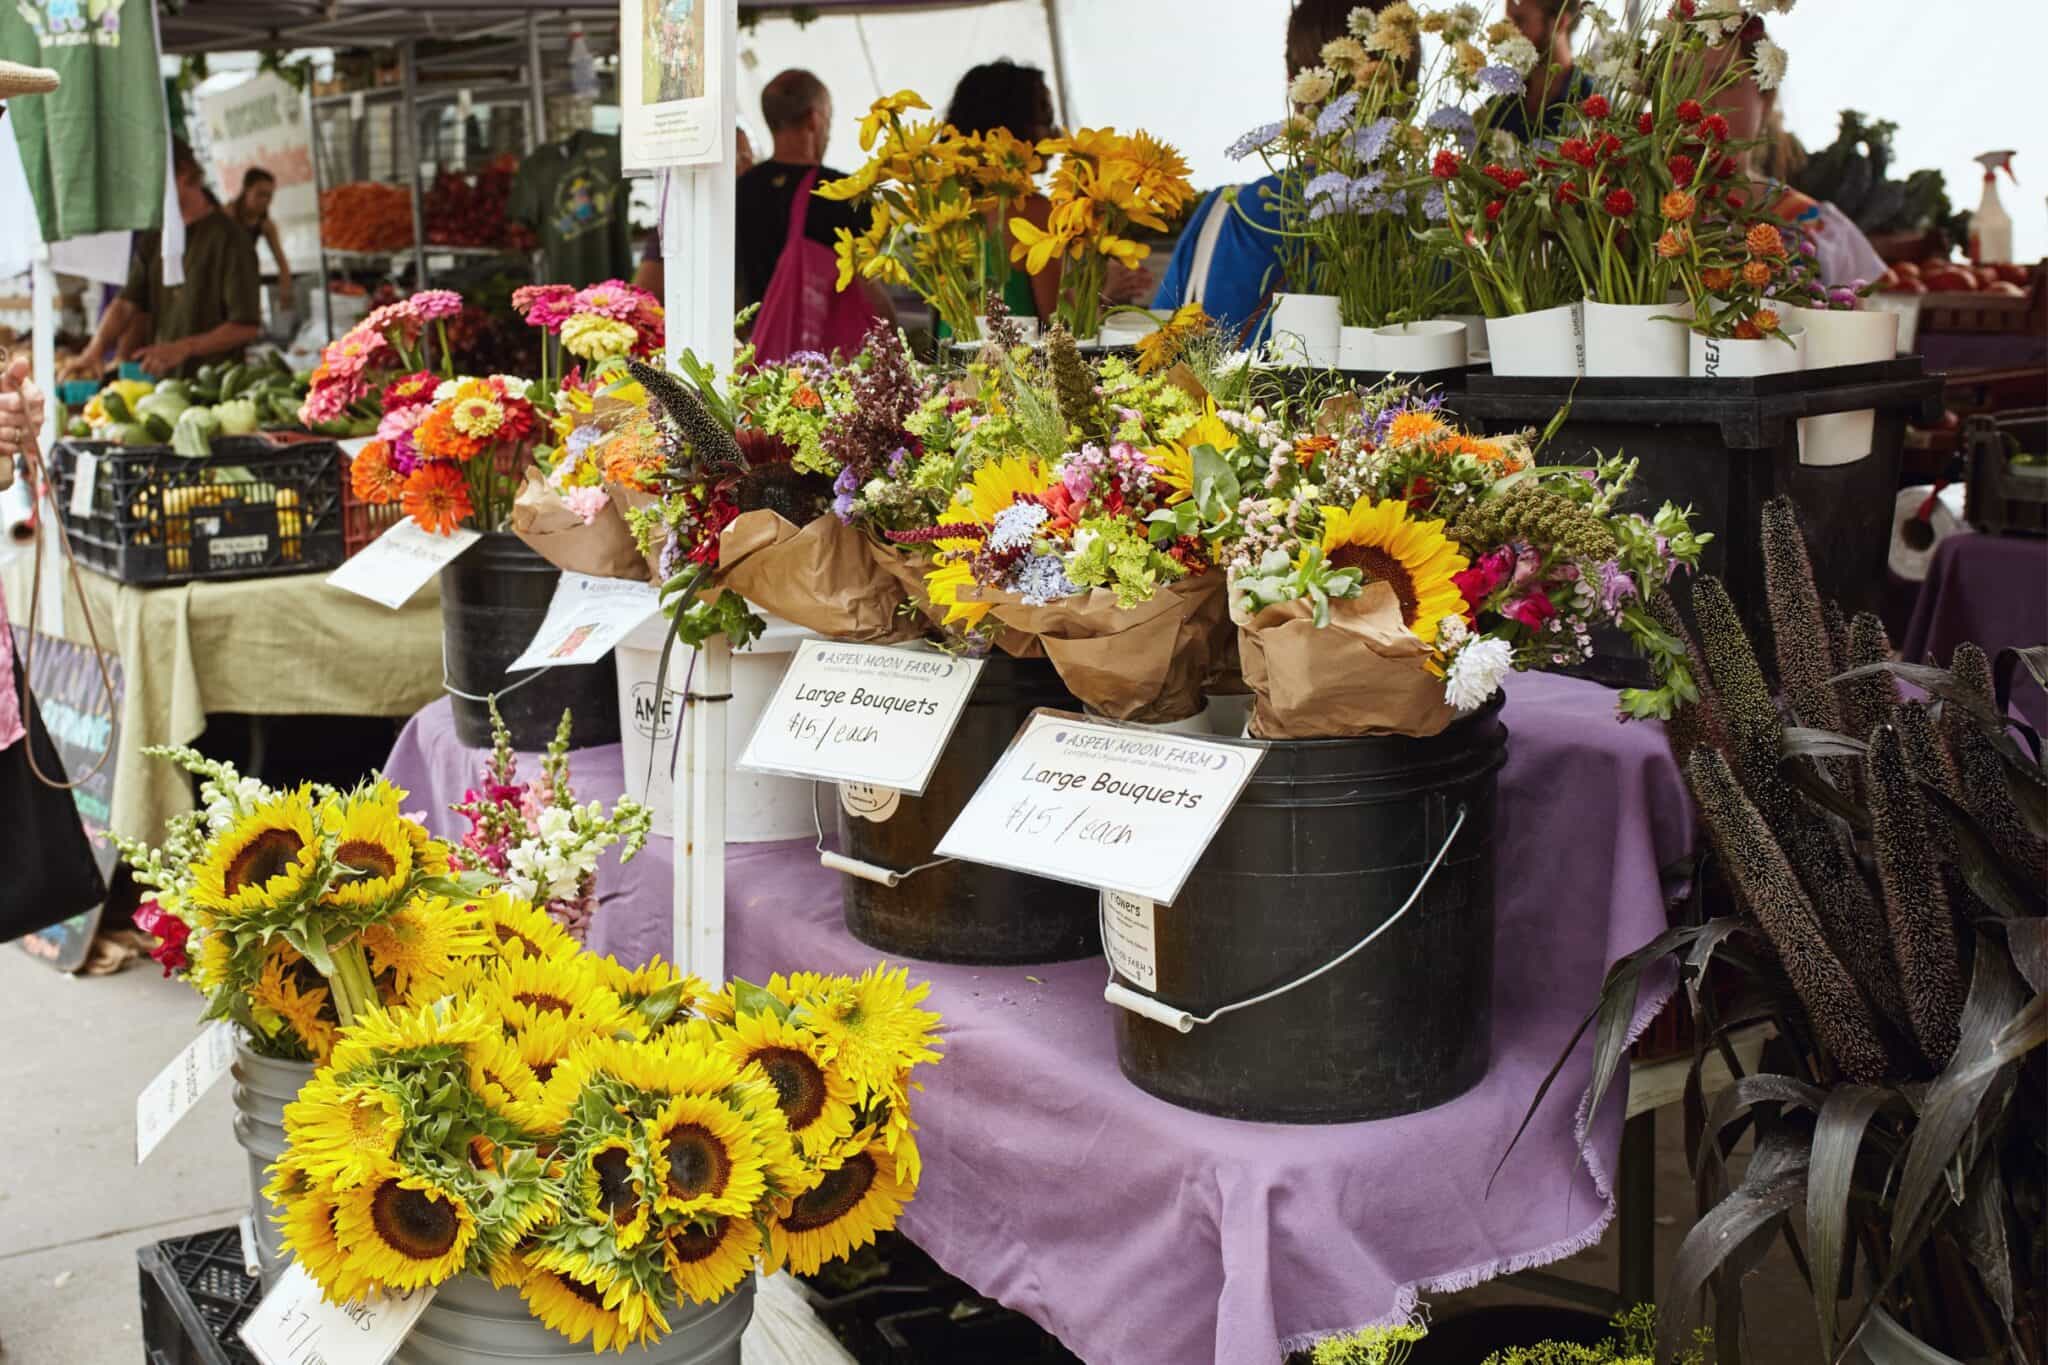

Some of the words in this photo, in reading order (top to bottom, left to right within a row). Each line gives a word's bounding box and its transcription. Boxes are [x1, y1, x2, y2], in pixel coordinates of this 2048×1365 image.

[1705, 338, 1721, 377] RES
[824, 651, 863, 666] ASPEN
[865, 654, 904, 669] MOON
[904, 660, 942, 675] FARM
[635, 696, 672, 724] AMF
[795, 683, 846, 708] Large
[850, 687, 939, 716] Bouquets
[1065, 734, 1116, 751] ASPEN
[1114, 739, 1165, 757] MOON
[1164, 747, 1214, 767] FARM
[1021, 762, 1087, 792] Large
[1091, 772, 1202, 809] Bouquets
[341, 1296, 377, 1332] wers
